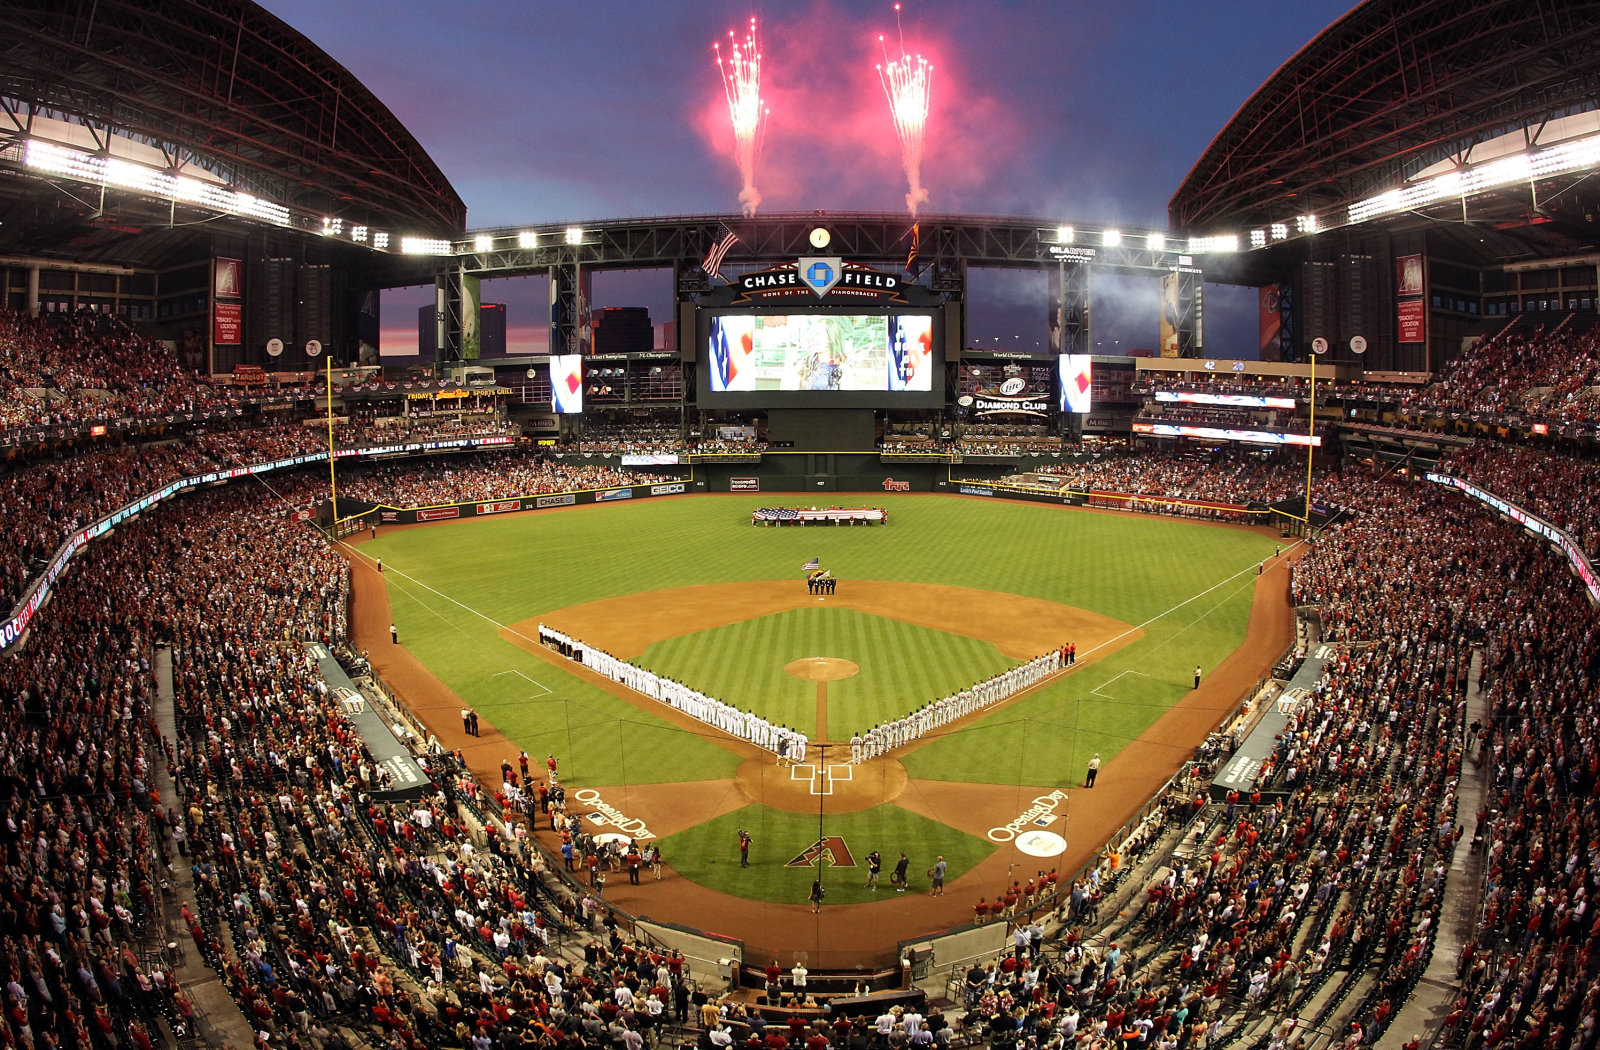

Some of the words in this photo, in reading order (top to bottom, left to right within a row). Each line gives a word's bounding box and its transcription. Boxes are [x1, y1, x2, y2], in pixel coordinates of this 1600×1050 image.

[1050, 246, 1070, 254] GILA
[744, 273, 796, 288] CHASE
[845, 273, 896, 288] FIELD
[831, 290, 878, 298] DIAMONDBACKS
[1204, 360, 1216, 370] 42
[1232, 362, 1245, 372] 20
[407, 392, 433, 400] FRIDAY'S
[976, 400, 1020, 410] DIAMOND
[1022, 401, 1048, 410] CLUB
[189, 477, 201, 486] SAY
[234, 467, 249, 477] STAR
[651, 483, 684, 495] GEICO
[882, 477, 910, 492] fry's
[540, 497, 565, 506] CHASE
[574, 789, 631, 826] Opening
[617, 818, 657, 840] Day
[987, 804, 1052, 842] Opening
[1031, 789, 1069, 810] Day
